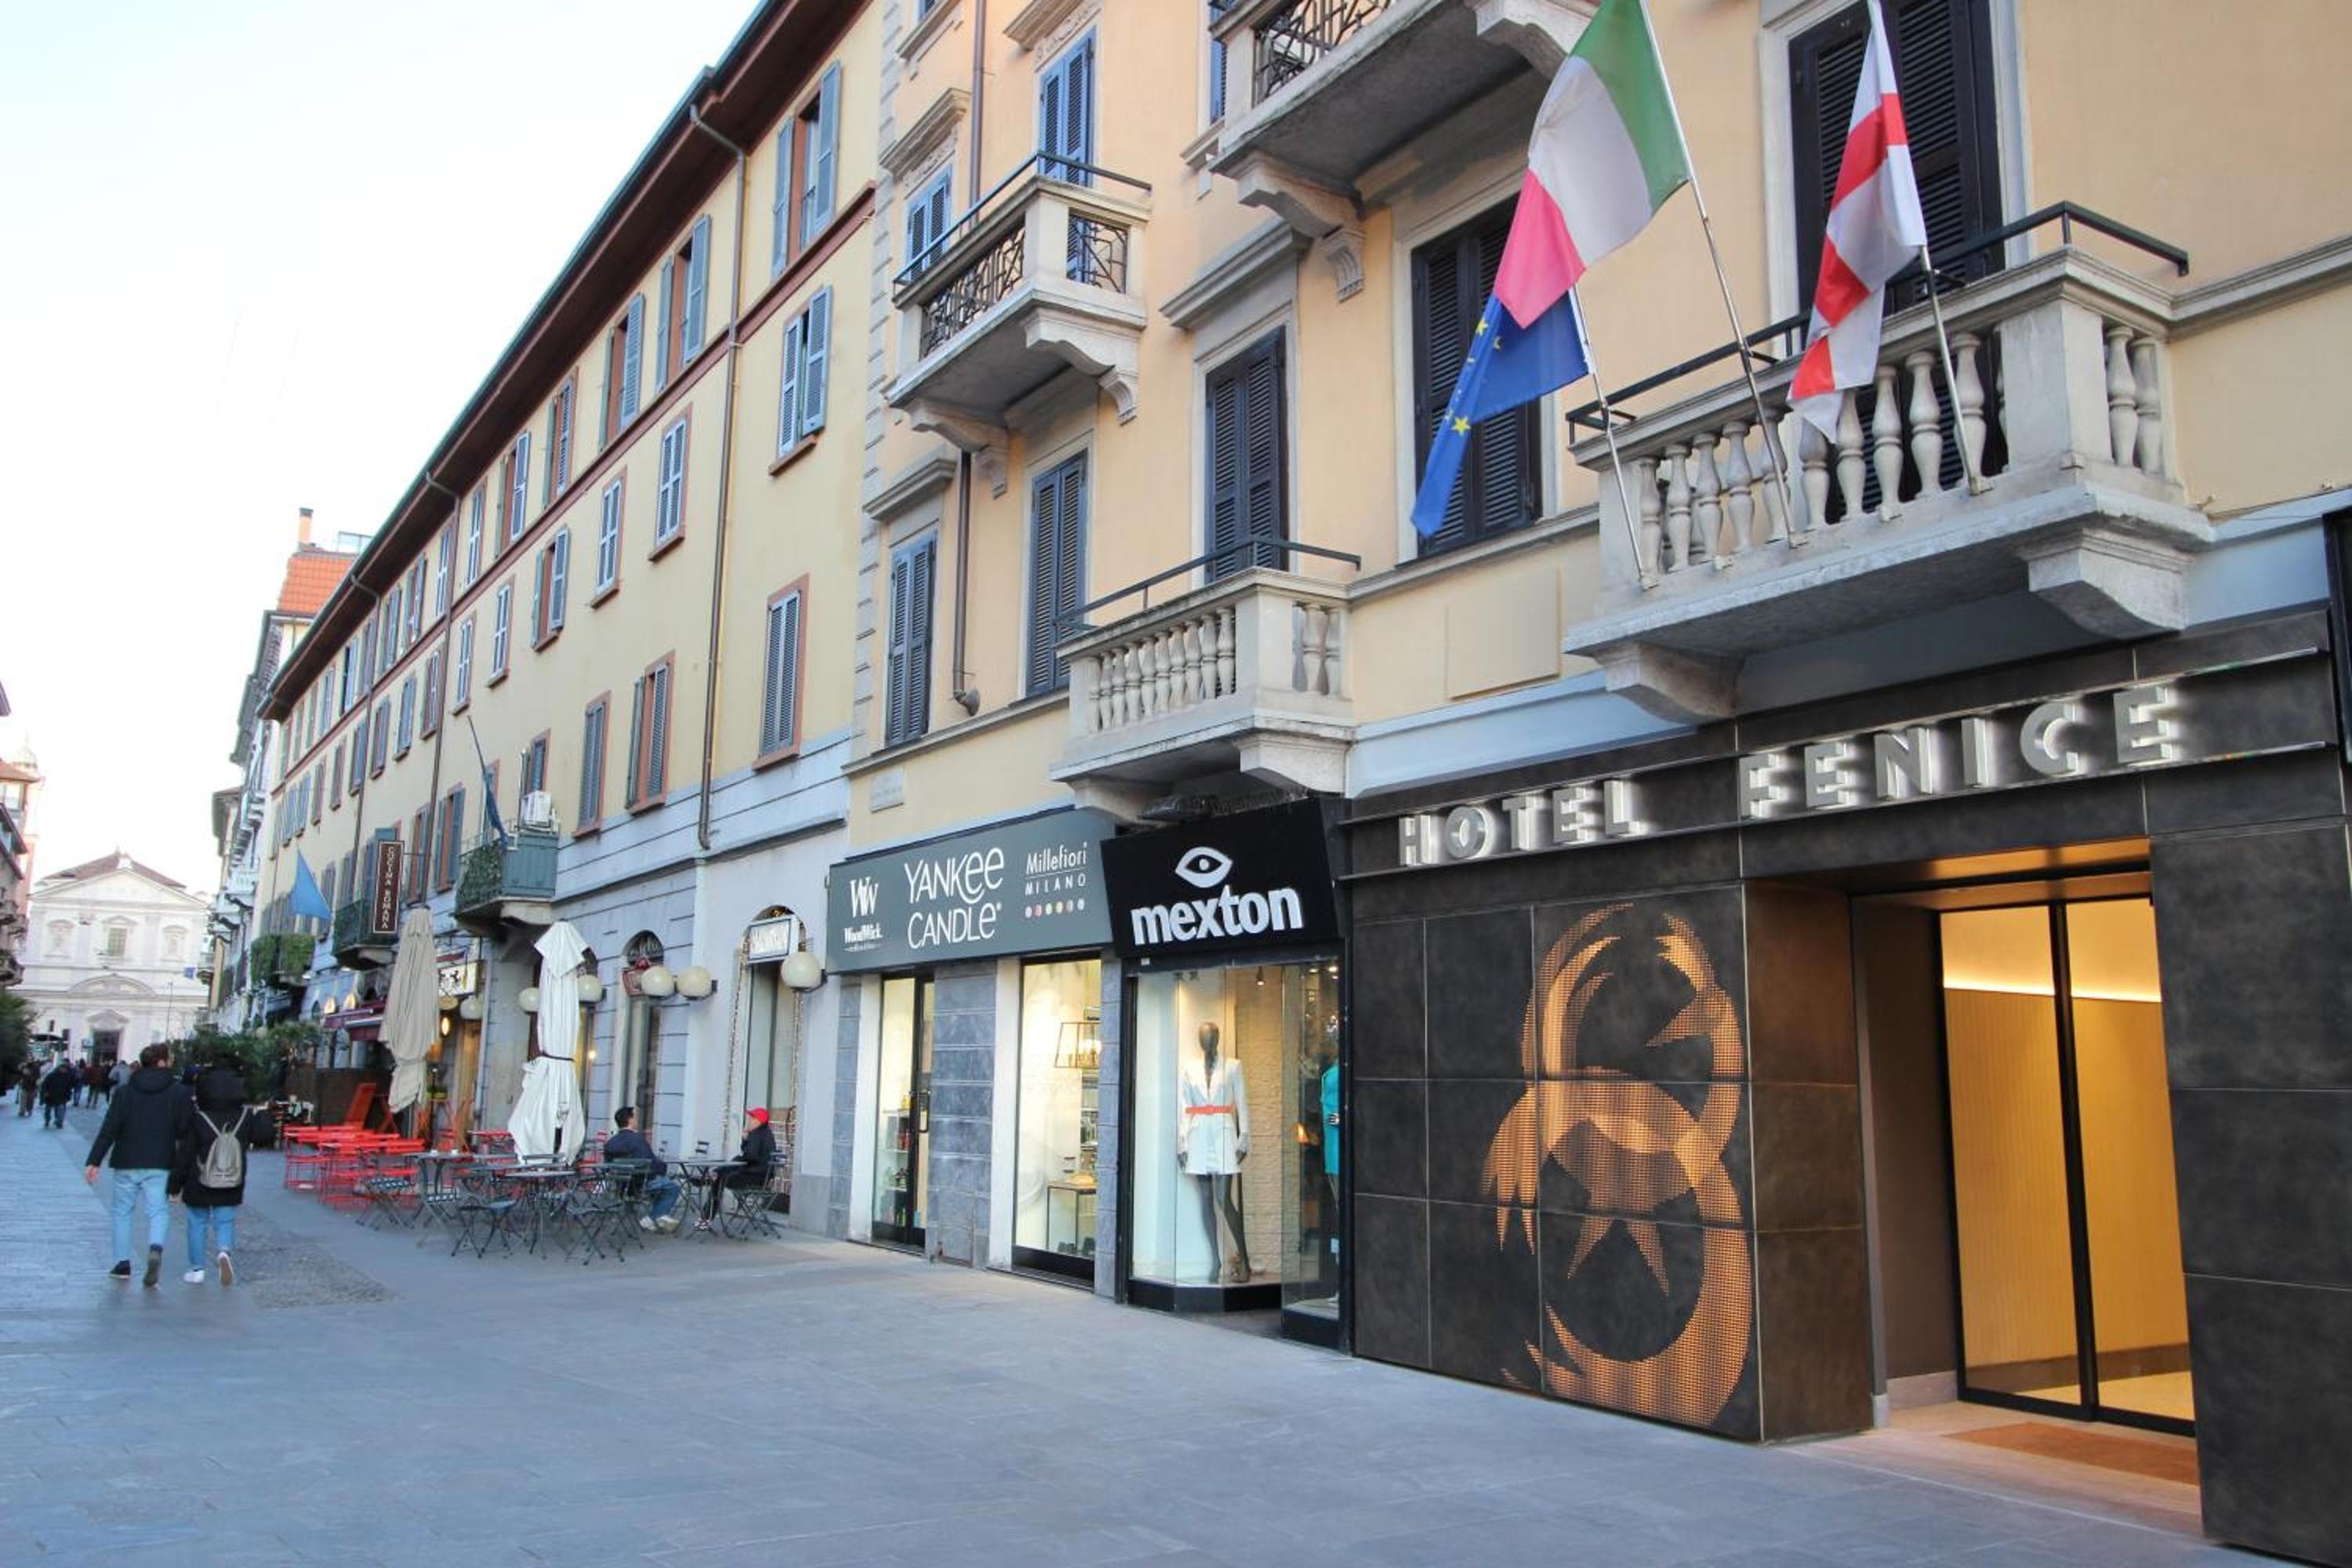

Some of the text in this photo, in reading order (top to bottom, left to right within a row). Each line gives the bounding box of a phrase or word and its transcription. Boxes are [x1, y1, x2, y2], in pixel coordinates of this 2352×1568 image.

[1399, 686, 2174, 867] HOTEL FENICE
[1025, 841, 1088, 876] Millefiori
[1025, 872, 1087, 897] MILANO
[1130, 883, 1305, 946] mexton
